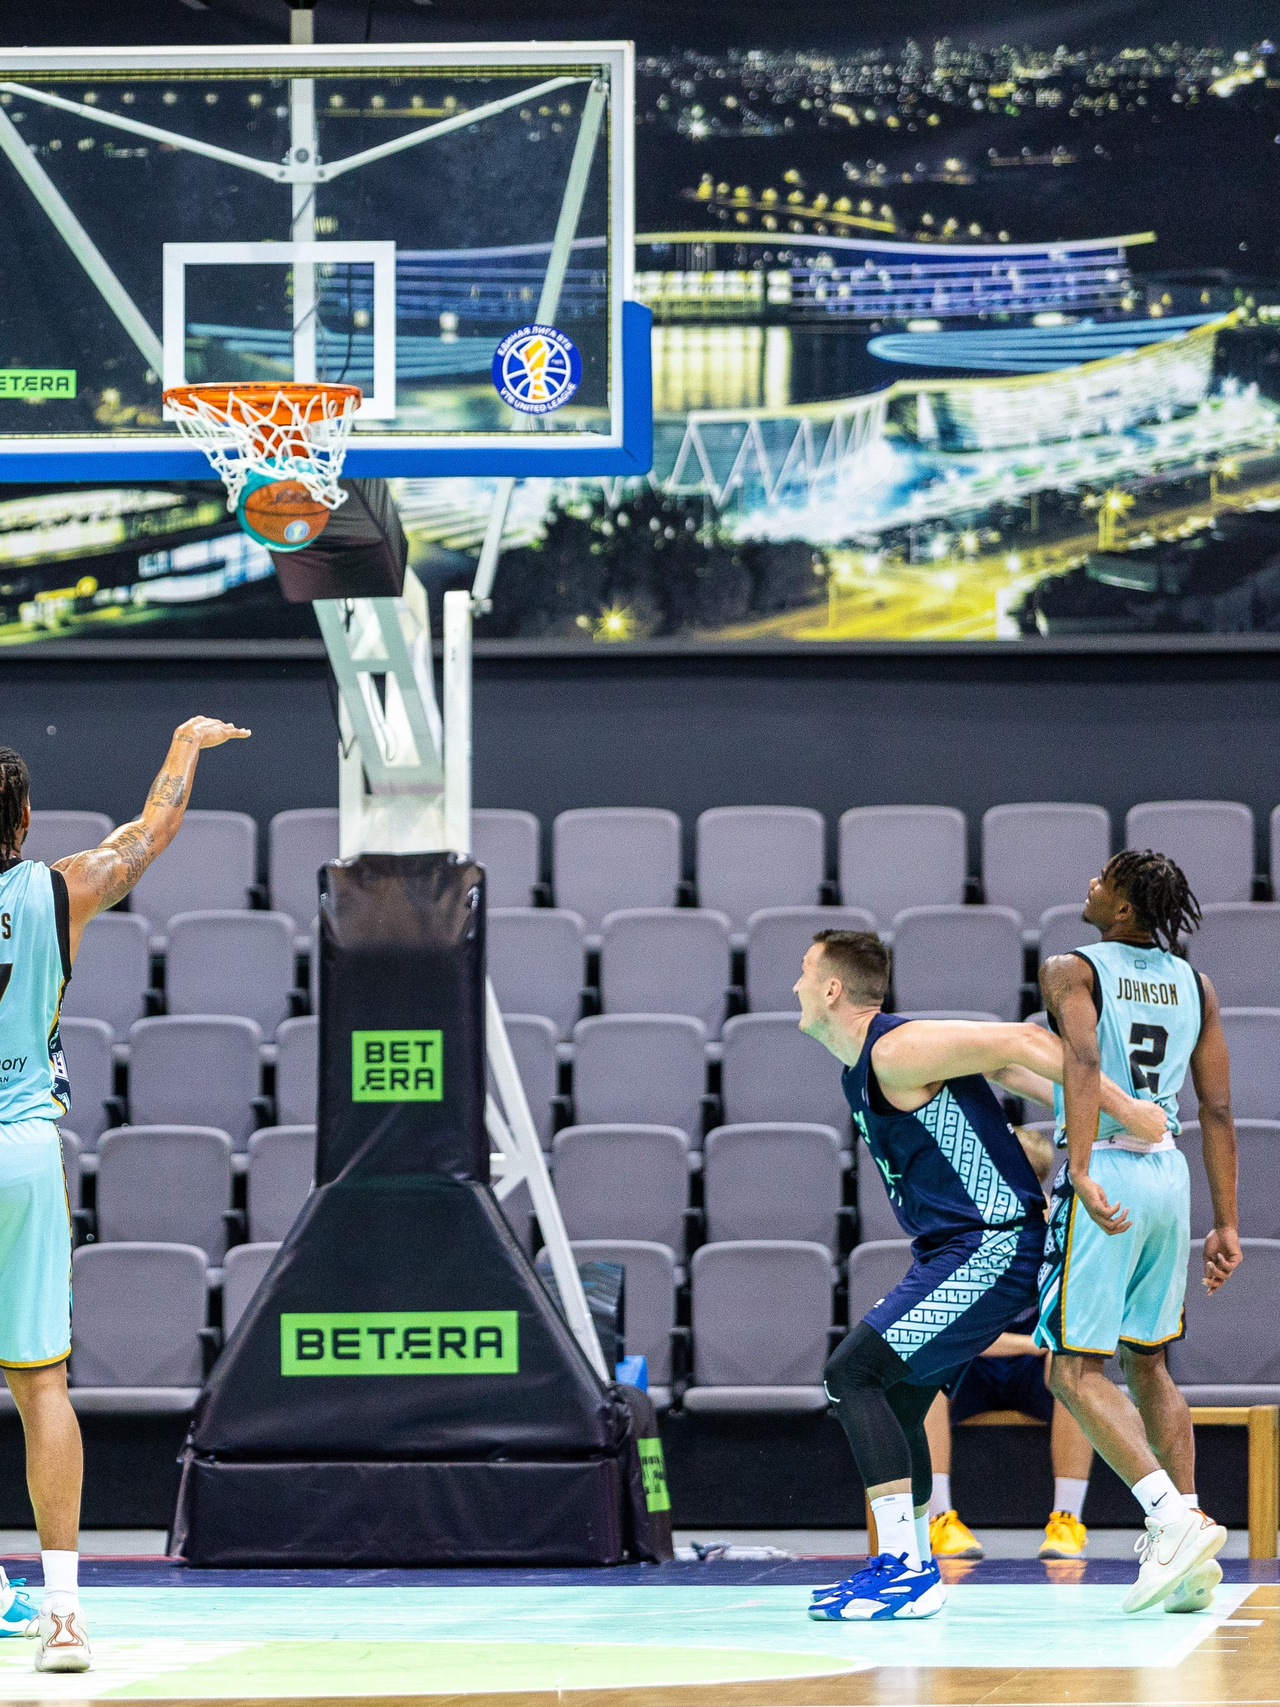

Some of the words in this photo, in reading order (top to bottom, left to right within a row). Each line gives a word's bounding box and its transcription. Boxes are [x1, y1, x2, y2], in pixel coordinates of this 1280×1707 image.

[514, 401, 547, 412] UNITED
[547, 382, 577, 409] LEAGUE
[1117, 977, 1178, 1006] JOHNSON
[365, 1041, 434, 1063] BET
[1129, 1022, 1169, 1094] 2
